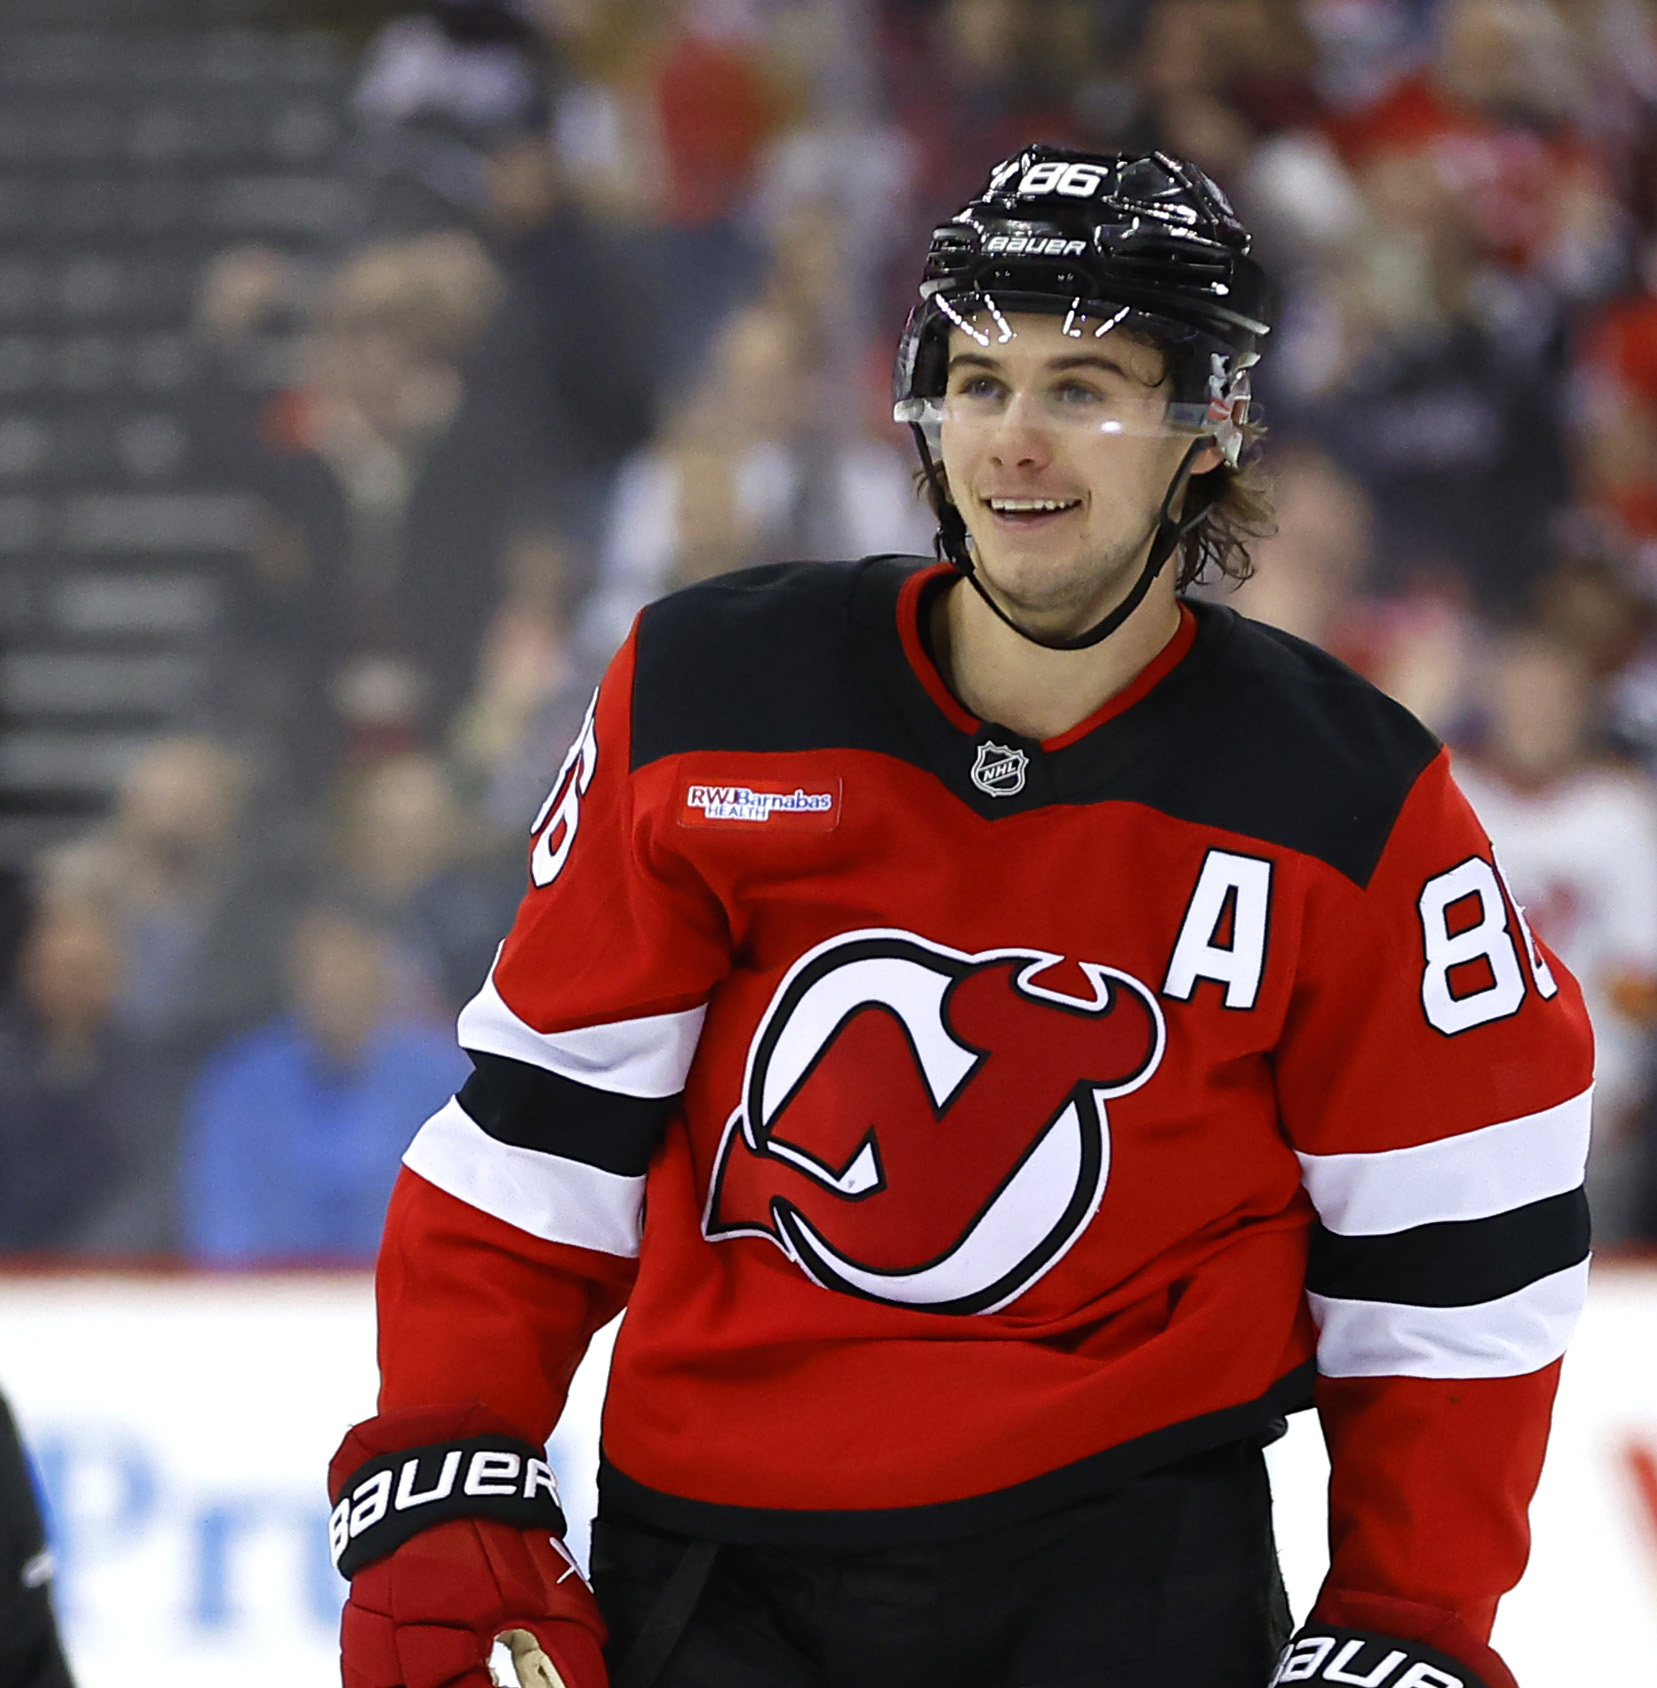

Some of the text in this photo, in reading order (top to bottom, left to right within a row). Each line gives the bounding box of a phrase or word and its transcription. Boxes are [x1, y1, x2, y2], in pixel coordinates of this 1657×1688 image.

[1017, 161, 1109, 197] 86
[983, 761, 1017, 782] NHL
[707, 805, 767, 818] HEALTH
[1162, 848, 1274, 1009] A
